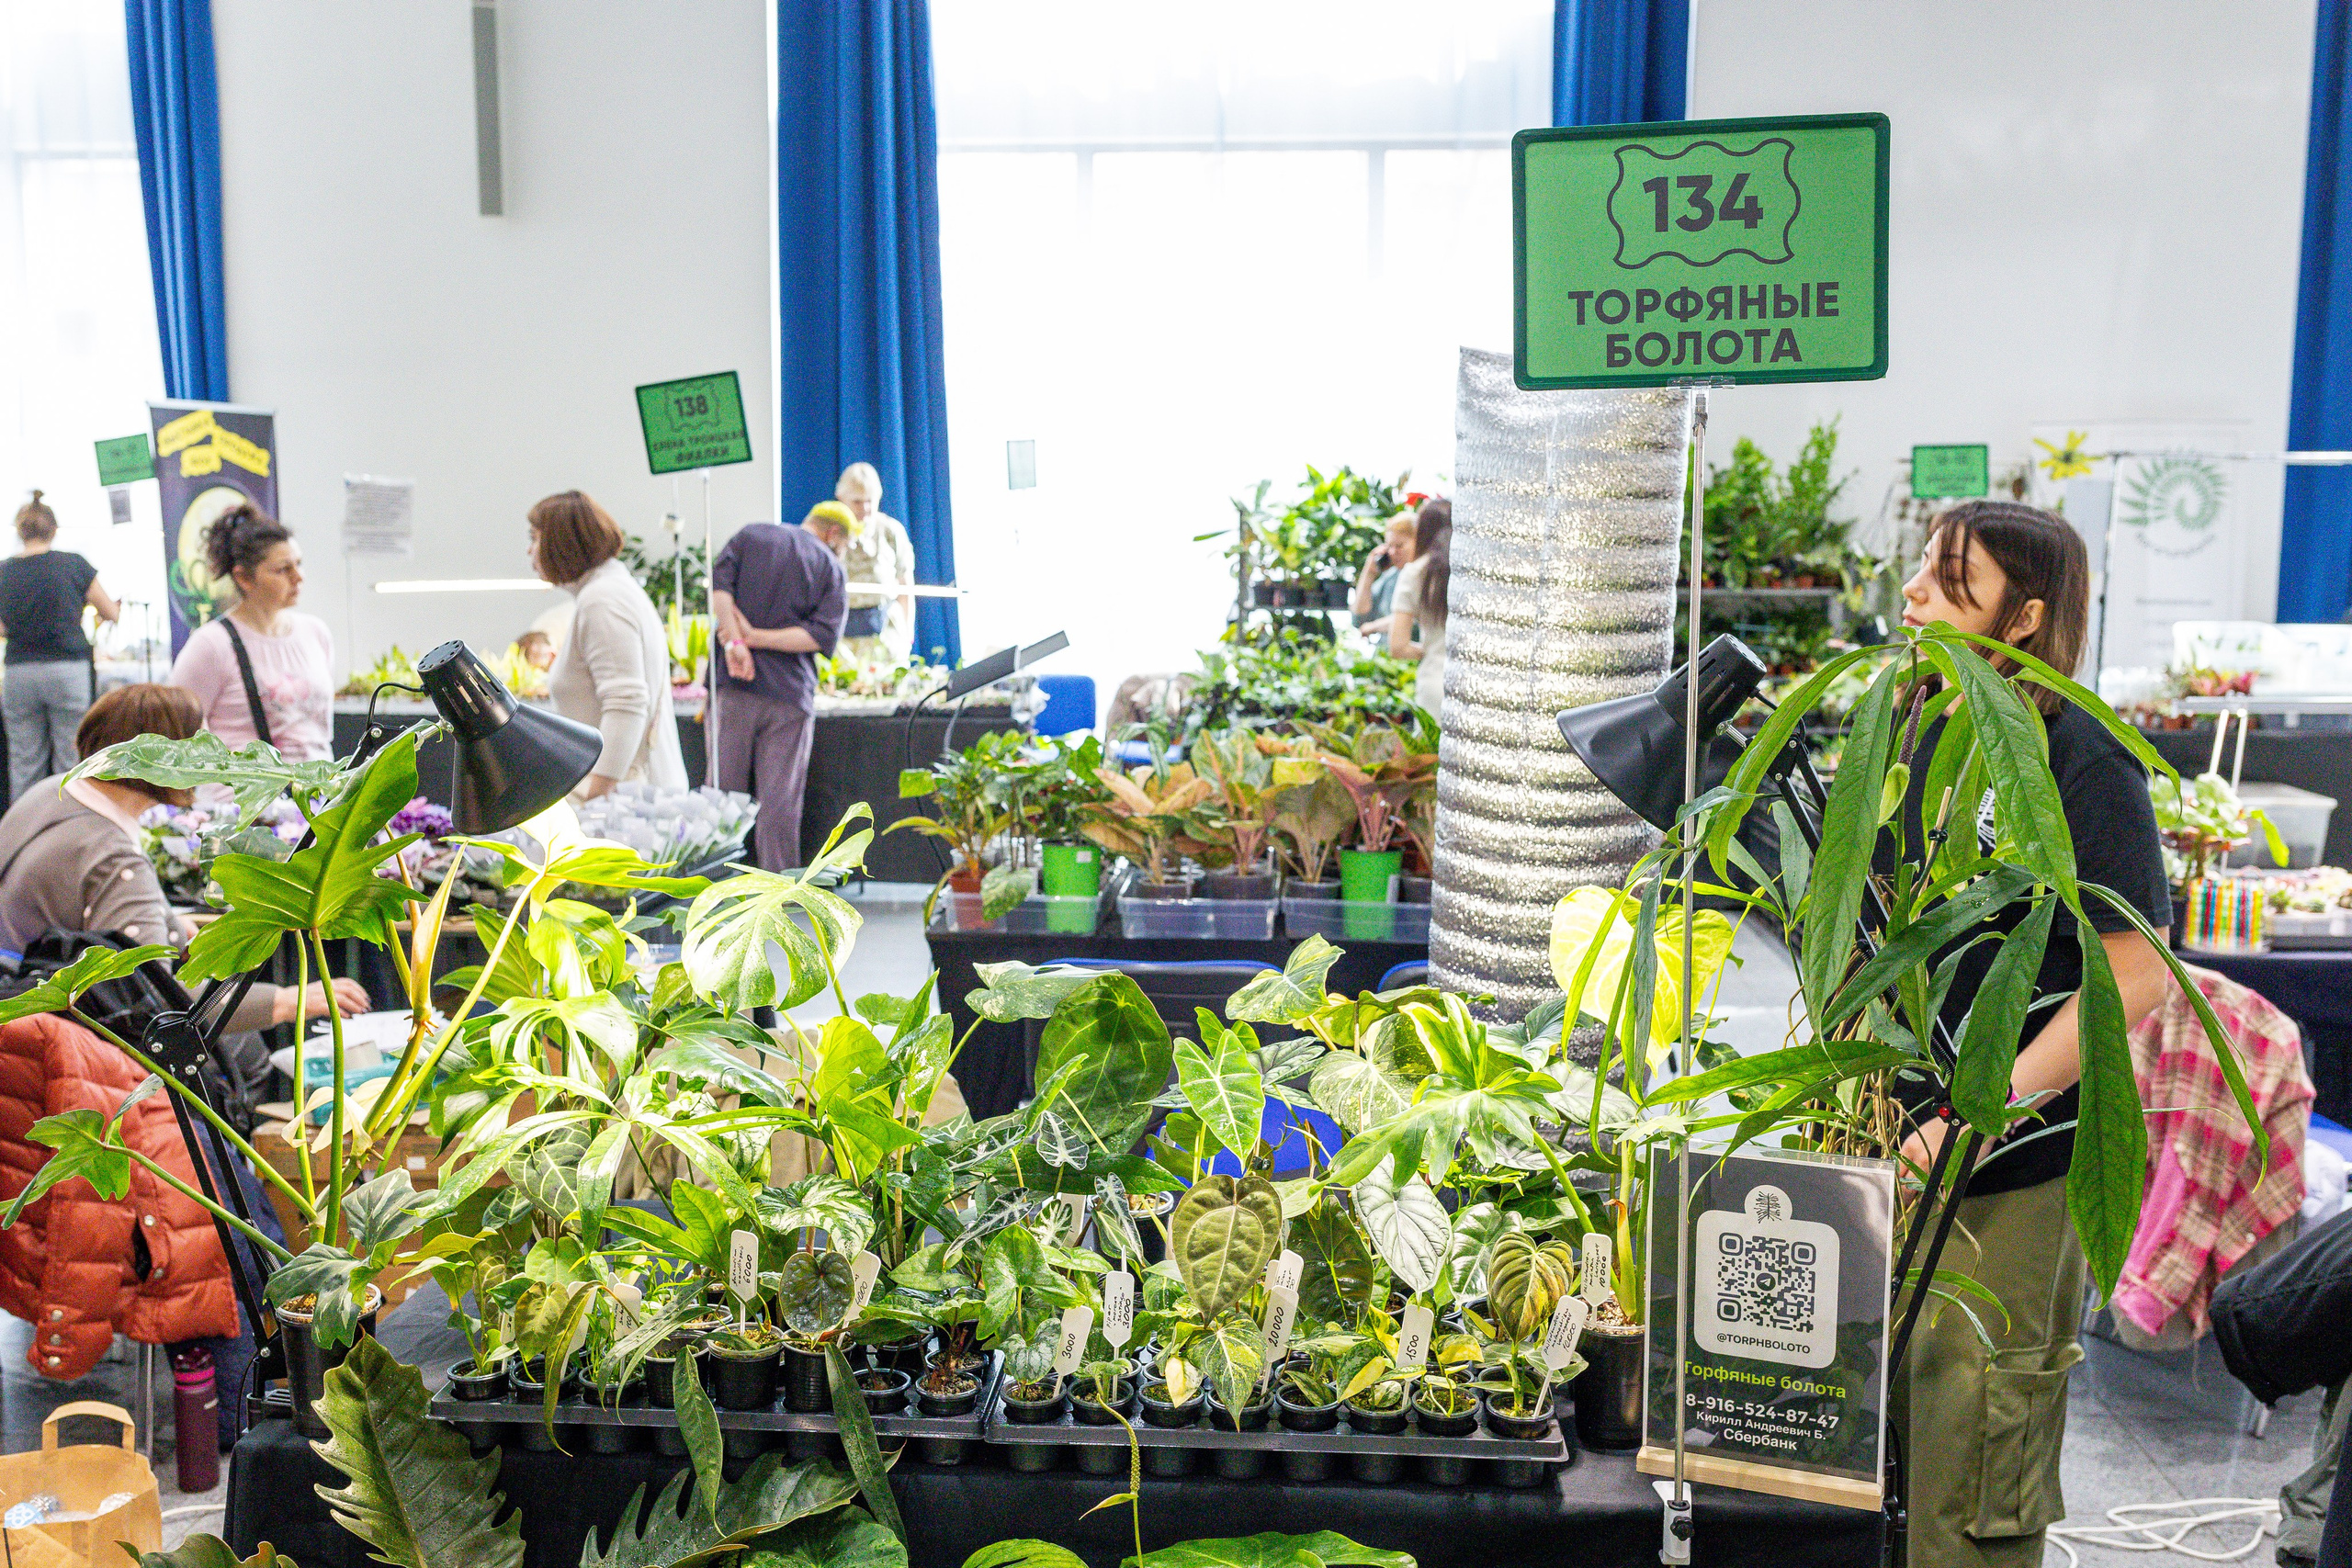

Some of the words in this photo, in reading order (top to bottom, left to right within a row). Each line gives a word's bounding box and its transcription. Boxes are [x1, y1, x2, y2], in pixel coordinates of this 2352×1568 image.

[1643, 173, 1763, 232] 134
[1567, 281, 1839, 326] ТОРФЯНЫЕ
[1606, 327, 1803, 367] БОЛОТА
[674, 394, 708, 417] 138
[743, 1254, 752, 1284] 6000
[1122, 1298, 1131, 1329] 3000
[1268, 1306, 1284, 1348] 20000
[1061, 1333, 1076, 1359] 3000
[1406, 1334, 1419, 1360] 1500
[1716, 1333, 1811, 1354] @TORPHBOLOTO
[1780, 1376, 1847, 1398] болота
[1685, 1393, 1839, 1429] 8-916-524-87-47
[1696, 1411, 1742, 1427] Кирилл
[1745, 1418, 1811, 1438] Андреевич
[1814, 1429, 1826, 1440] Б.
[1723, 1428, 1798, 1450] Сбербанк
